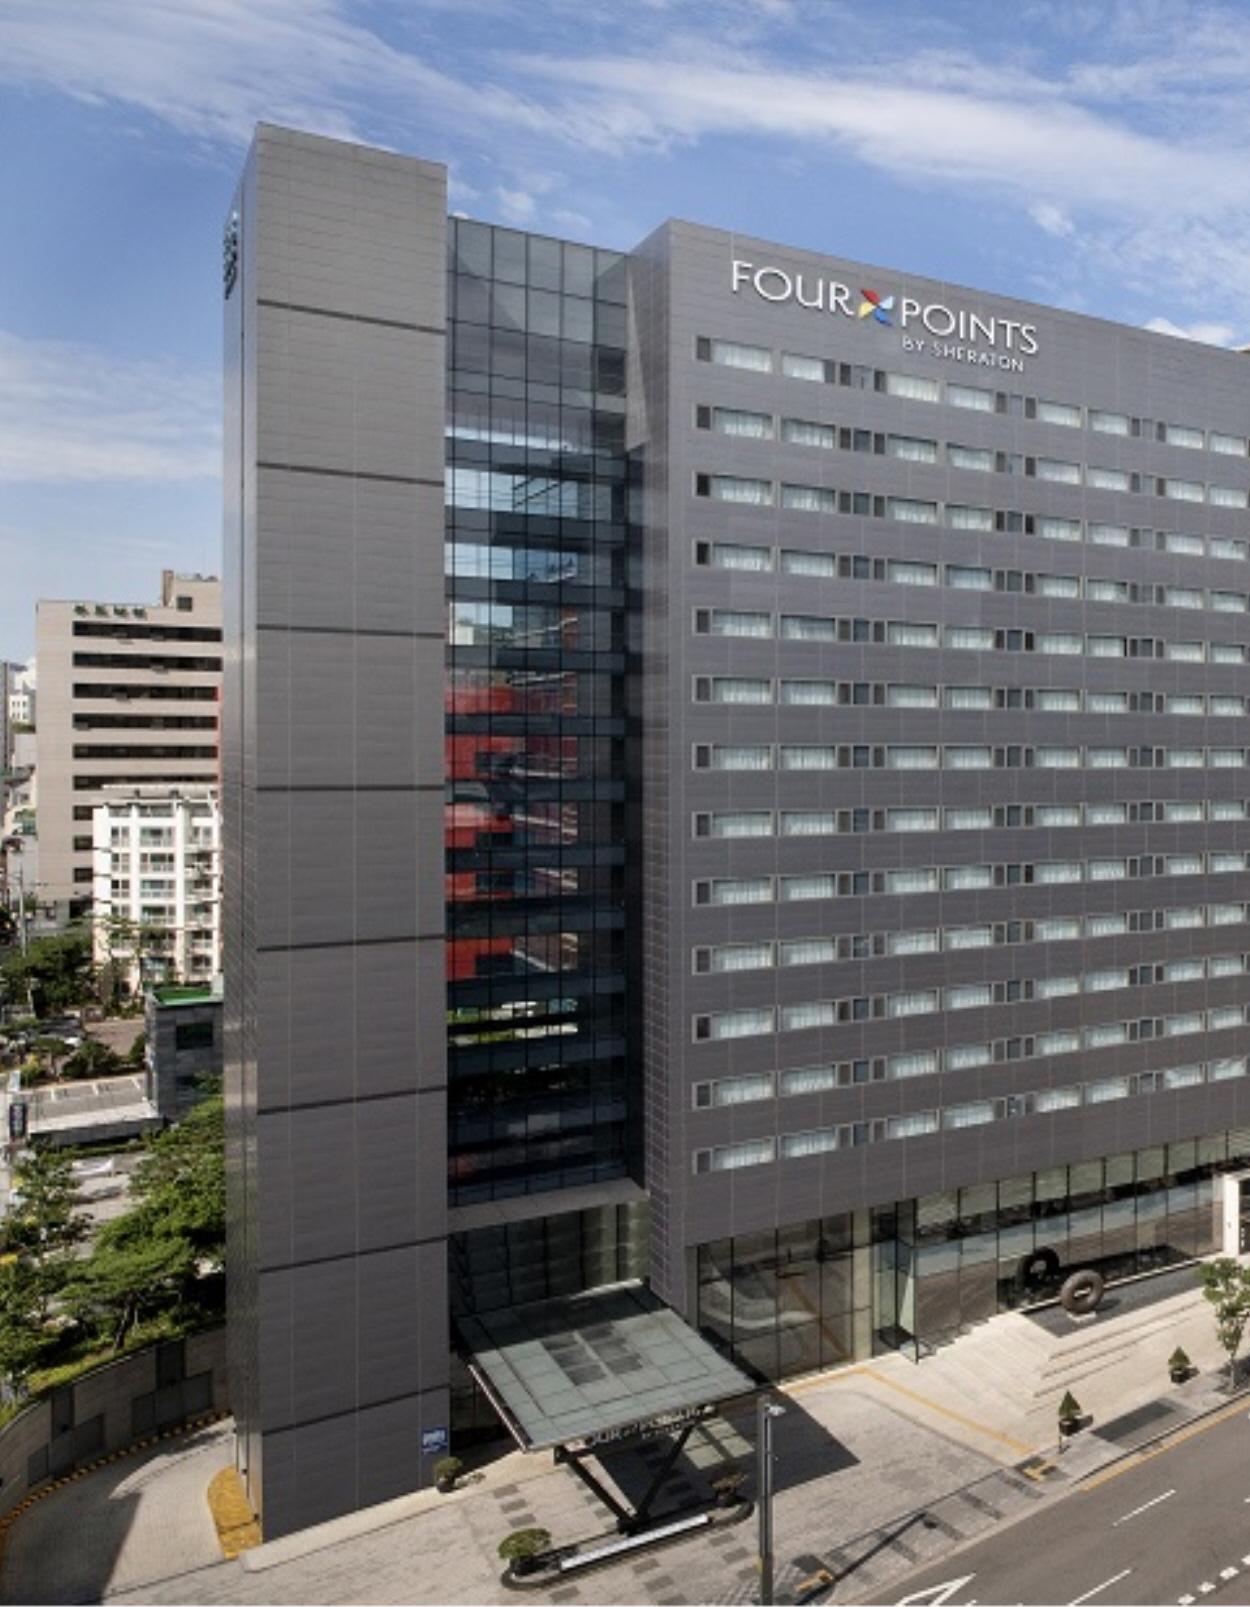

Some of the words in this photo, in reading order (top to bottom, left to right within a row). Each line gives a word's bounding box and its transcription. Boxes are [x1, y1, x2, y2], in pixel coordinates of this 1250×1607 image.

[732, 259, 855, 317] FOUR
[901, 298, 1039, 354] POINTS
[902, 335, 925, 351] BY
[932, 342, 1024, 372] SHERATON
